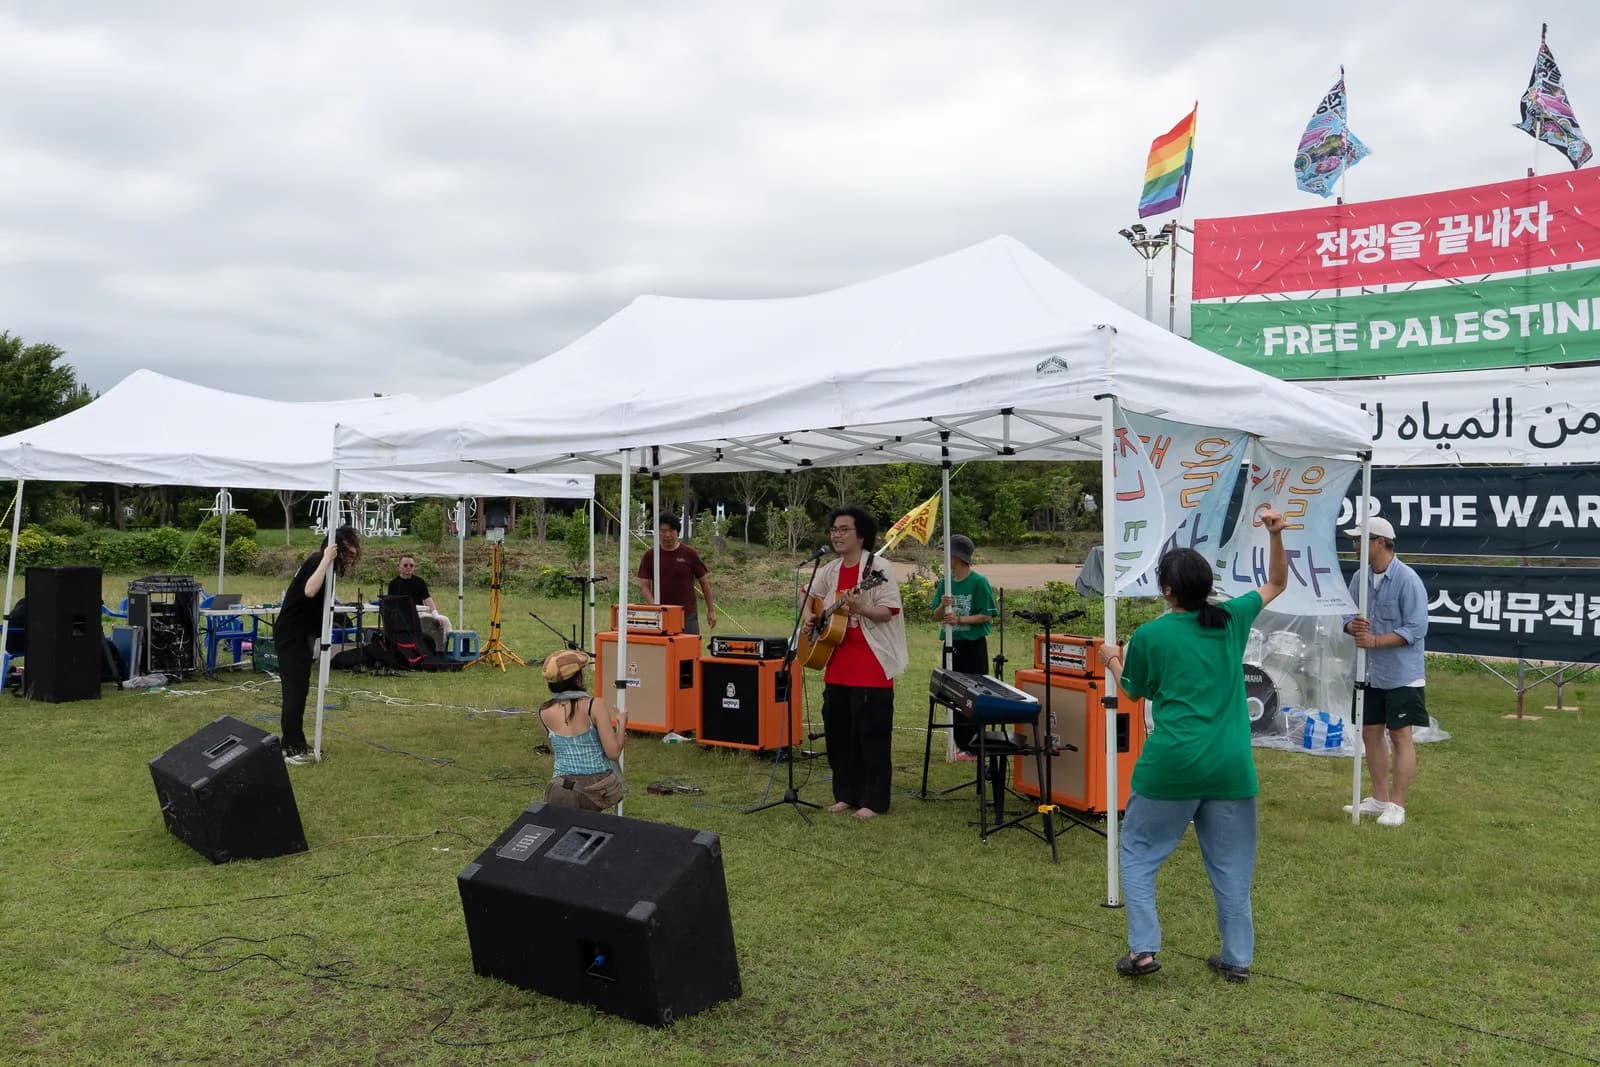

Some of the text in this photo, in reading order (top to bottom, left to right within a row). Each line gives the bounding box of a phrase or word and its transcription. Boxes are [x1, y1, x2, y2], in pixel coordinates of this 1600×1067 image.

[1315, 201, 1553, 267] 전쟁을 끝내자
[1263, 322, 1358, 356] FREE
[1398, 397, 1512, 449] المياه
[1529, 407, 1600, 448] من
[1336, 495, 1600, 528] OP THE WAR
[1427, 590, 1600, 637] 스앤뮤직
[1244, 674, 1263, 683] MAHA
[511, 832, 542, 852] JBL
